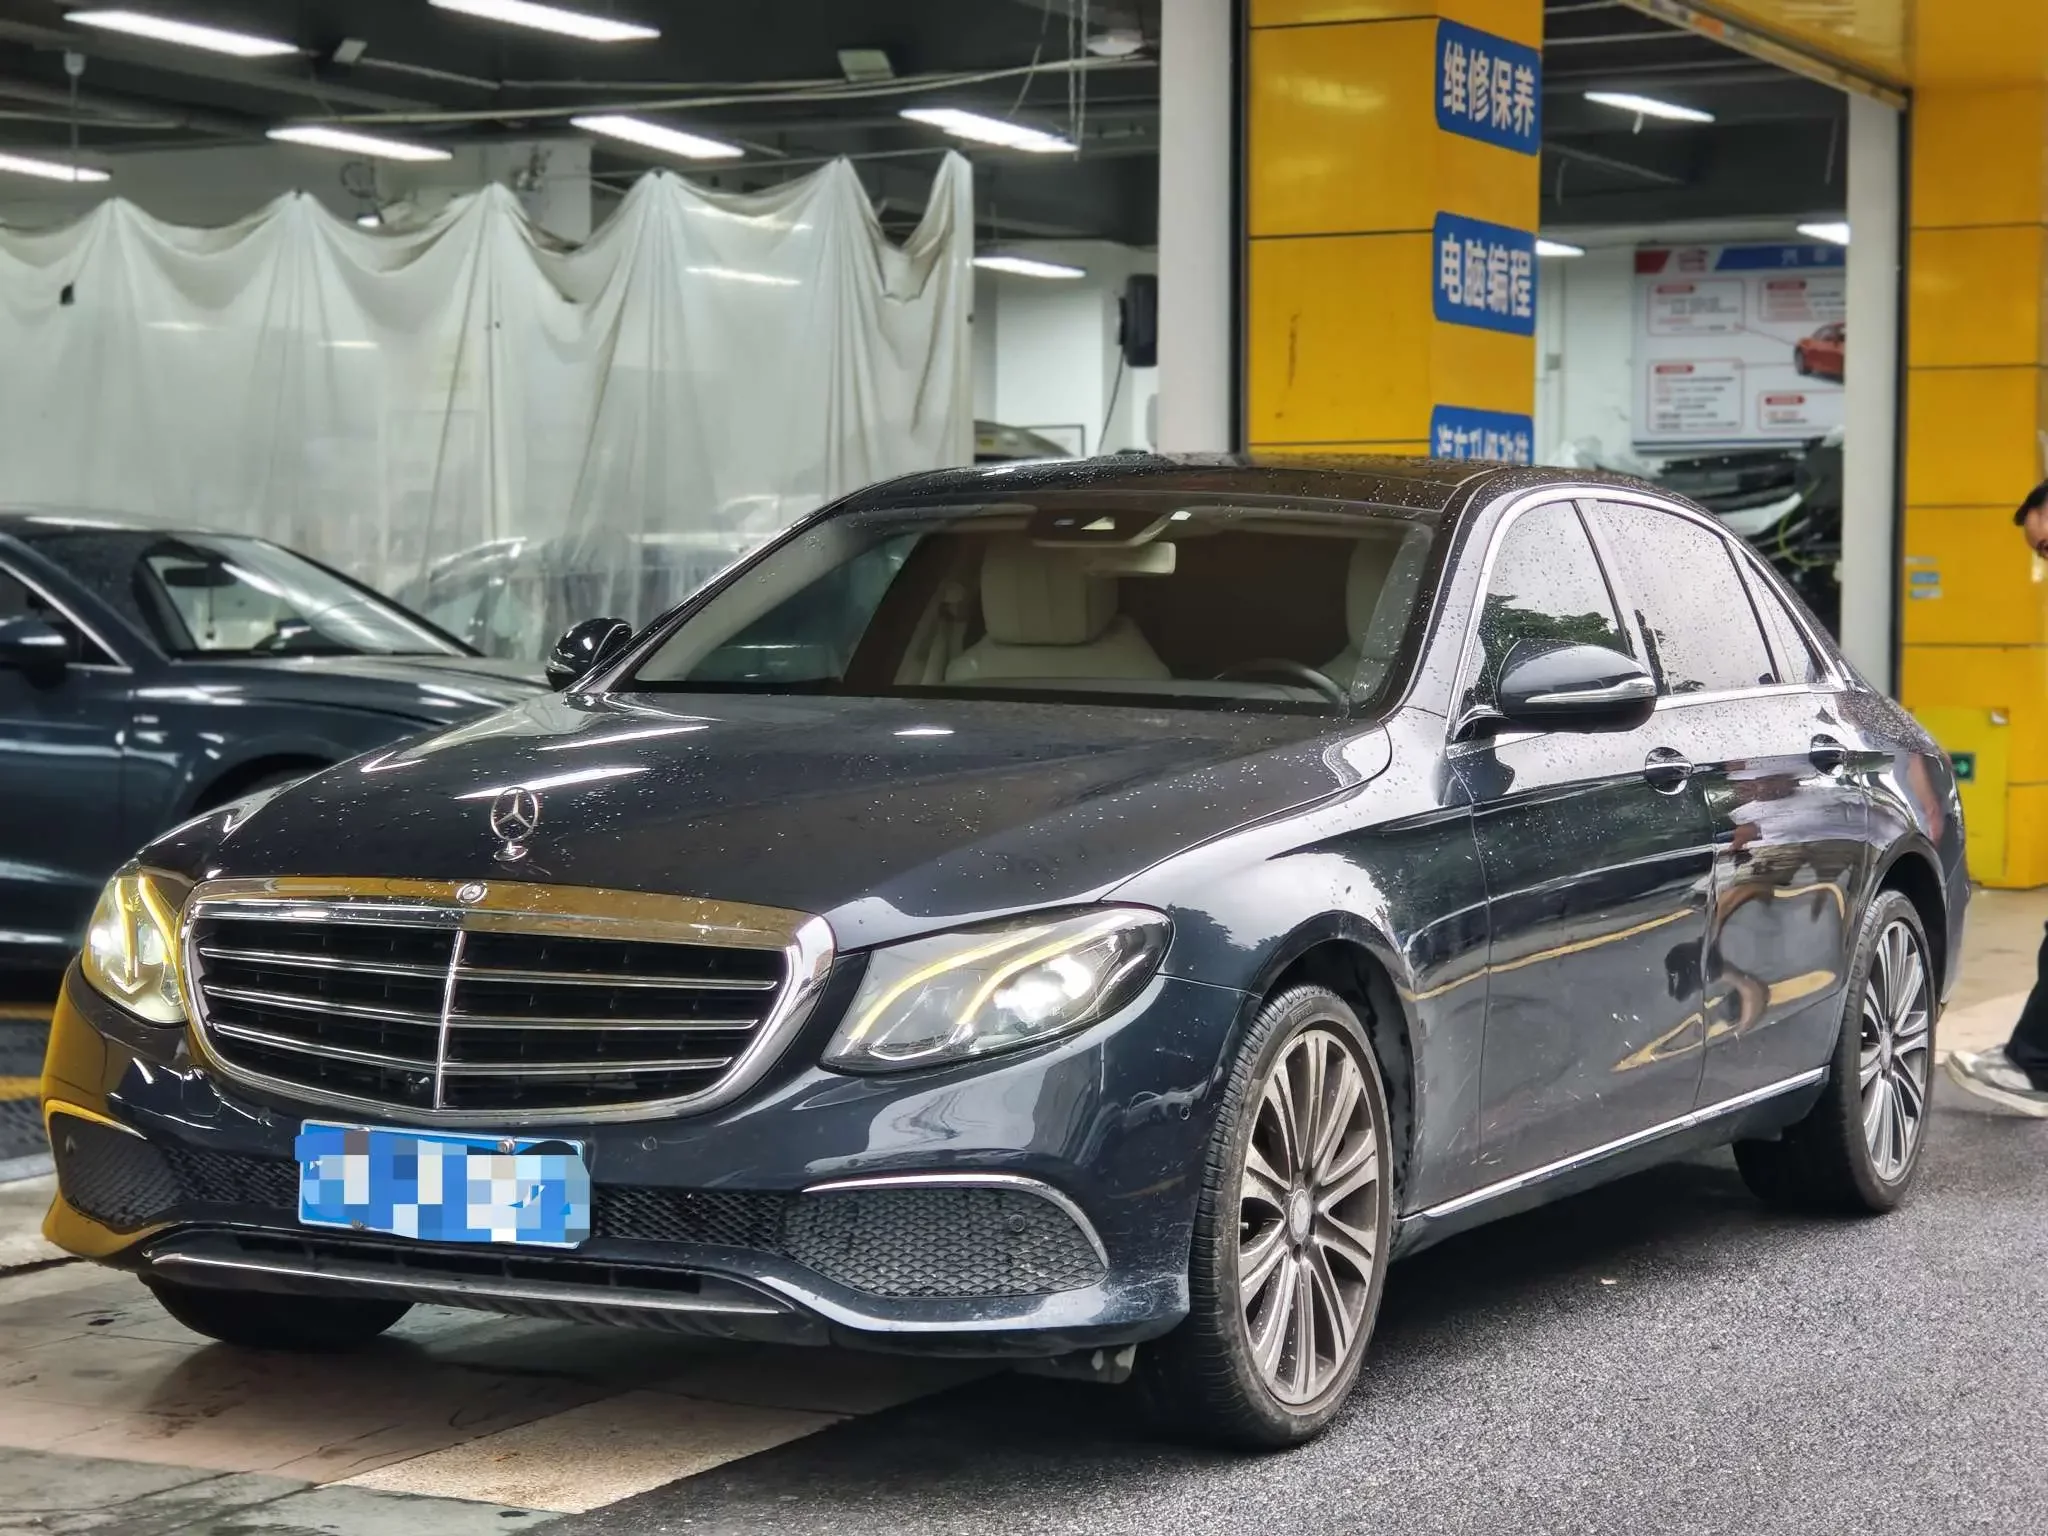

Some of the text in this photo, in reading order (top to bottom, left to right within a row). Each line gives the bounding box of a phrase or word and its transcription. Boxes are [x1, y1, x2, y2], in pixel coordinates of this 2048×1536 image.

[1443, 39, 1535, 137] 维修保养
[1440, 232, 1532, 318] 电脑编程
